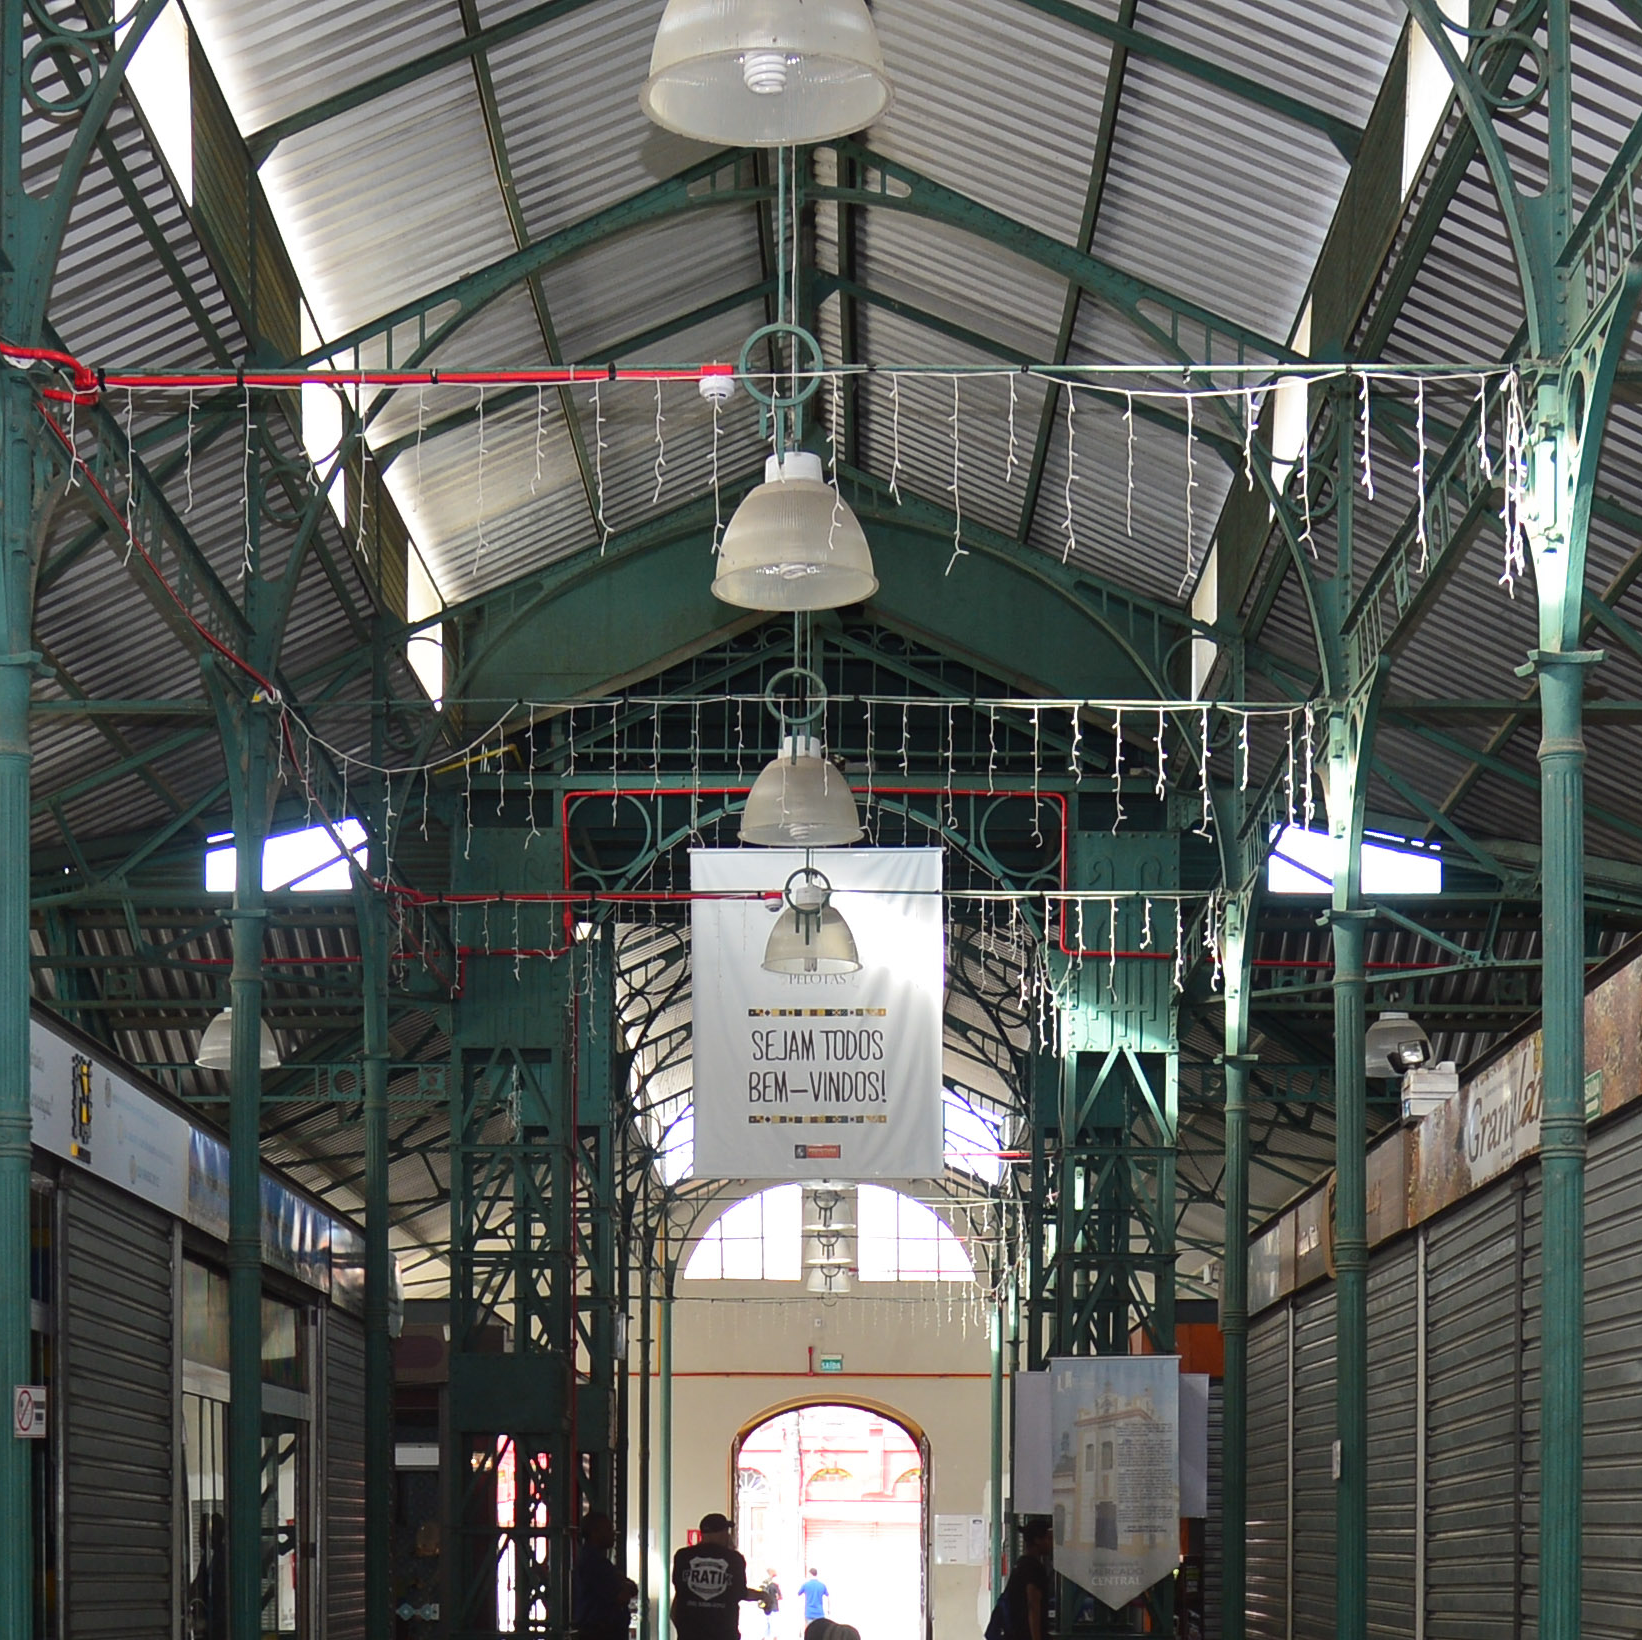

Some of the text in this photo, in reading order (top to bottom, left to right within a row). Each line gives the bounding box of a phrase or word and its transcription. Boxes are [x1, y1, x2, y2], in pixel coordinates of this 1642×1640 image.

[751, 1029, 884, 1061] SEJAM TODOS
[748, 1070, 887, 1103] BEM-VINDOS!
[1091, 1576, 1142, 1586] CENTRAL
